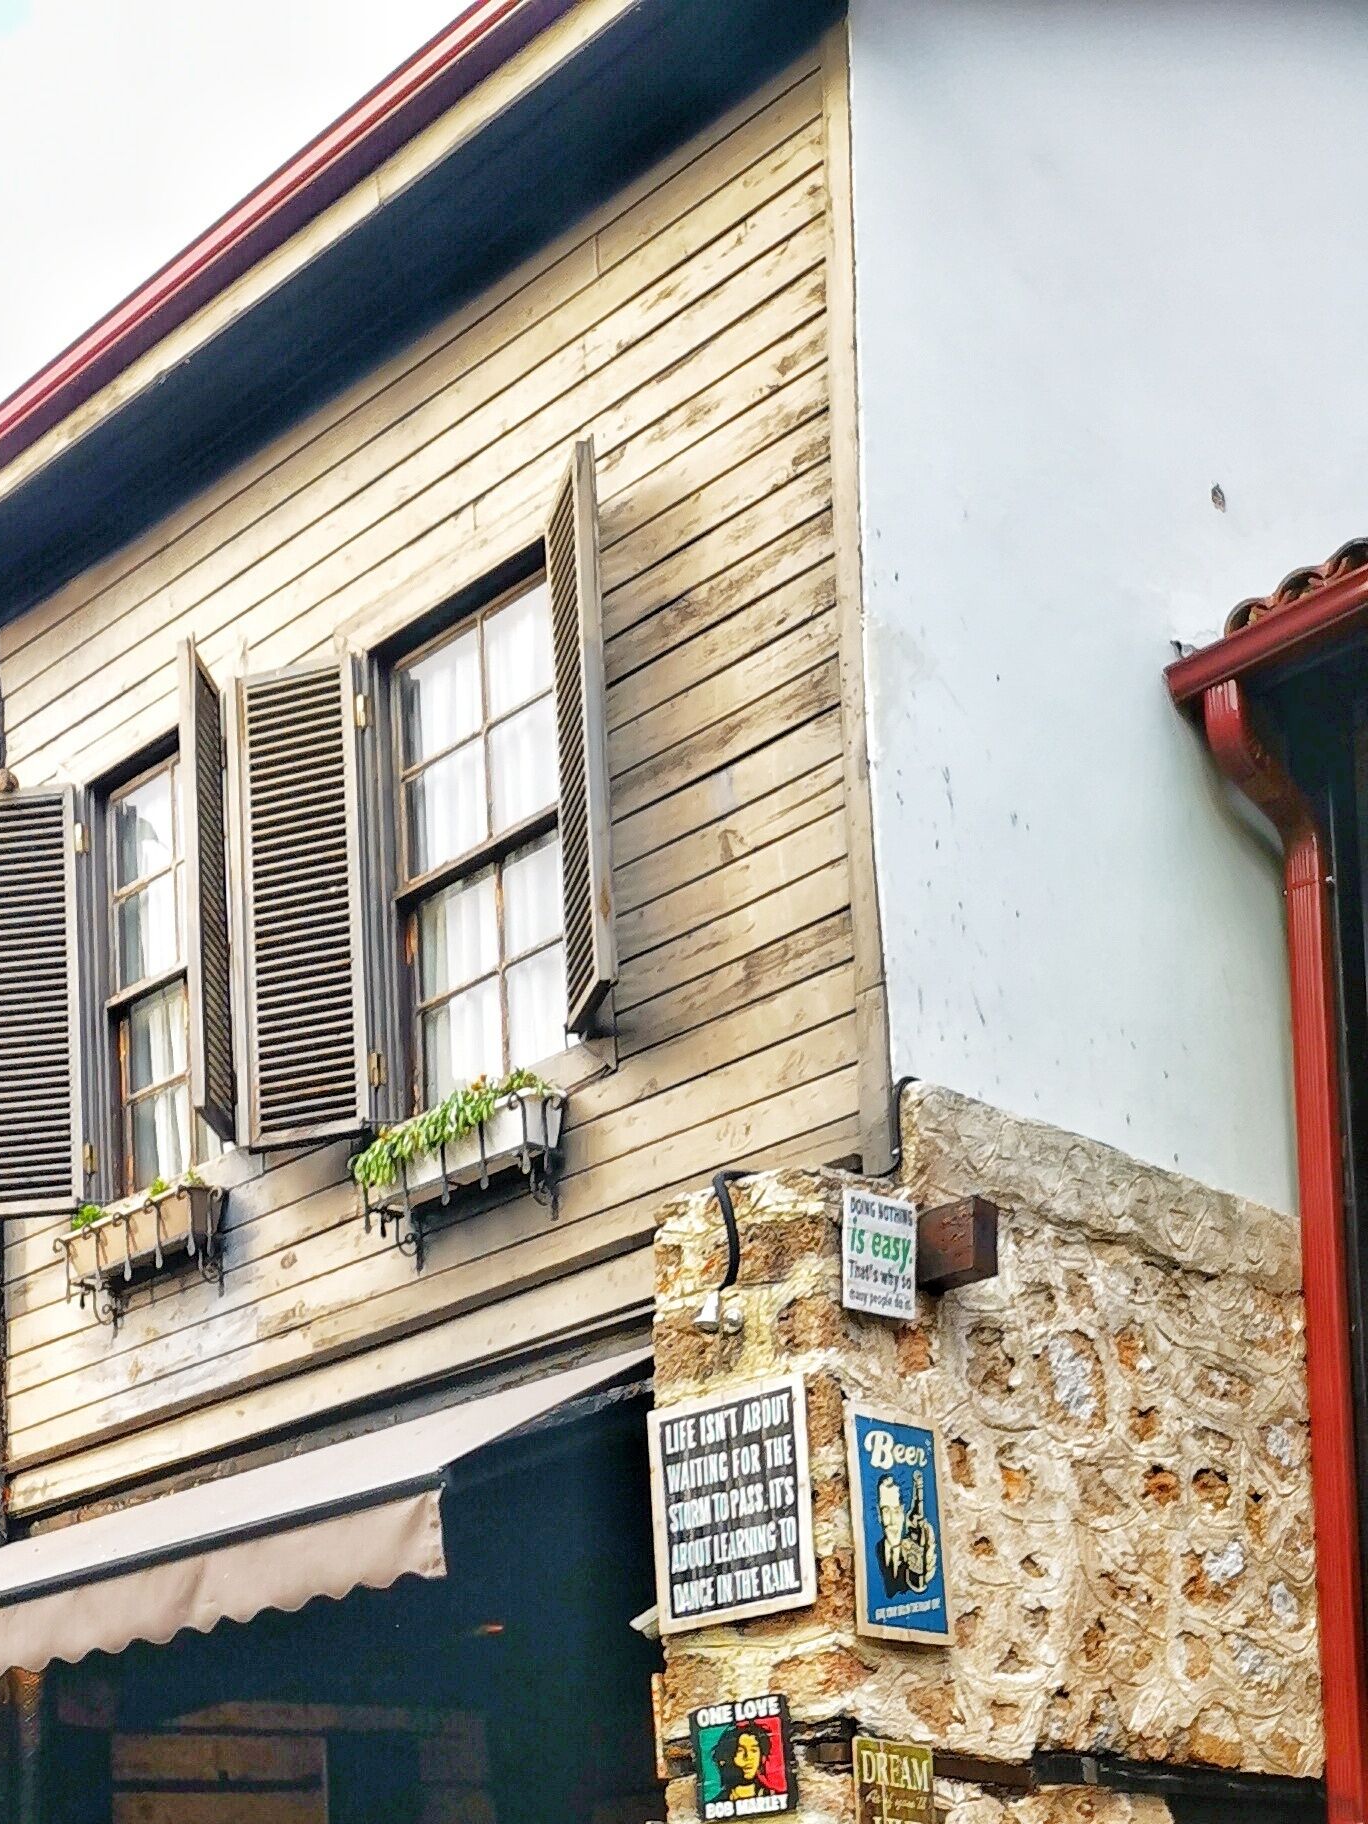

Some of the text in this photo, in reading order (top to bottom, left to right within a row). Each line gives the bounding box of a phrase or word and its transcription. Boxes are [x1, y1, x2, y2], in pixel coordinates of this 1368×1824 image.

[850, 1216, 913, 1274] is easy.
[848, 1259, 912, 1292] That's why so
[665, 1393, 790, 1455] LIFE ISN'T ABOUT
[864, 1430, 927, 1470] Beer
[666, 1434, 793, 1494] WAITING FOR THE
[668, 1475, 795, 1533] STORM TO PASS. IT'S
[671, 1516, 797, 1574] ABOUT LEARNING TO
[673, 1557, 800, 1613] DANCE IN THE RAIN.
[696, 1696, 781, 1728] ONE LOVE
[861, 1750, 930, 1792] DREAM
[705, 1793, 789, 1819] BOB MARLEY
